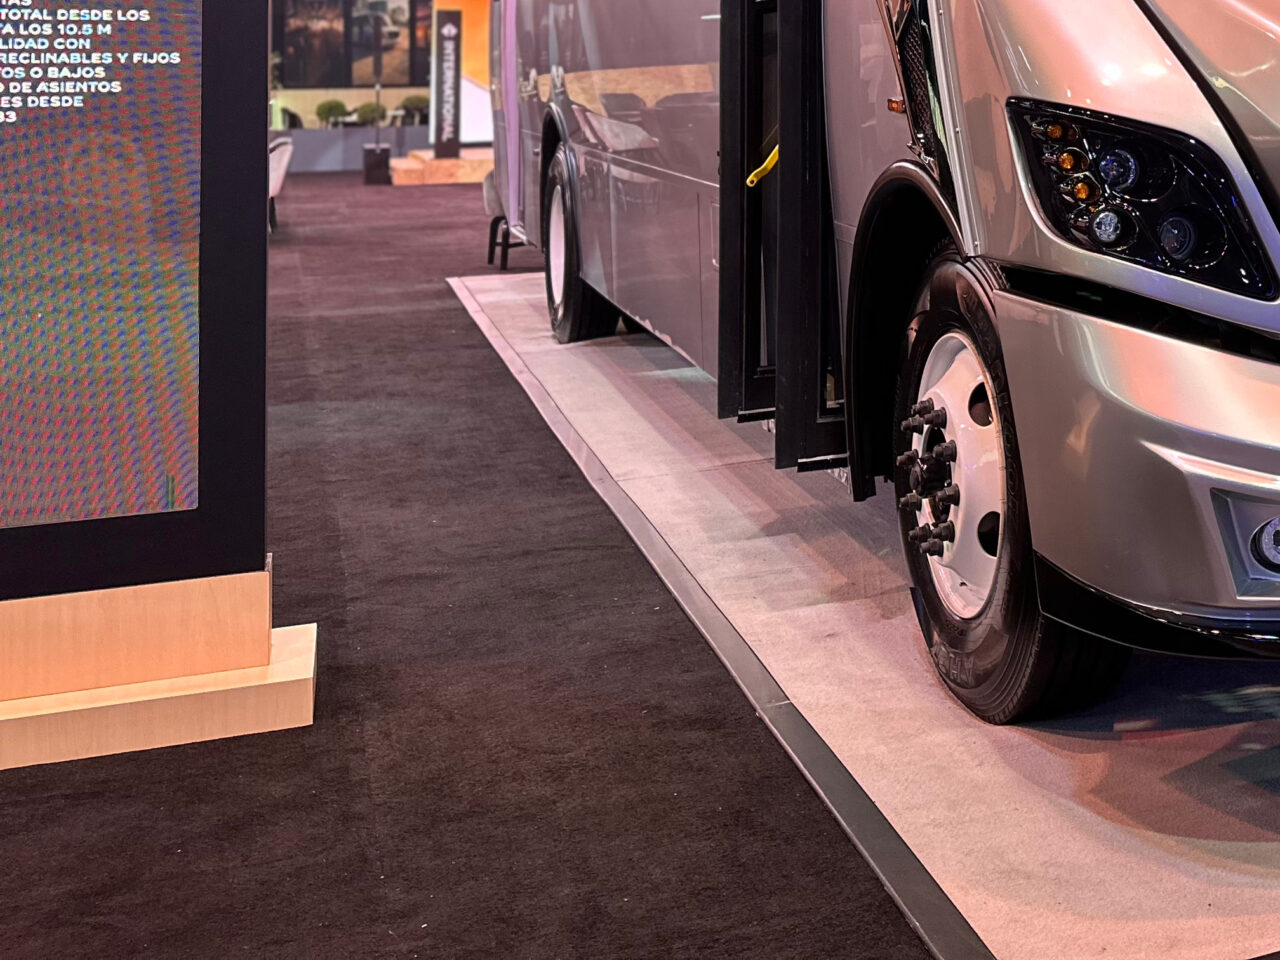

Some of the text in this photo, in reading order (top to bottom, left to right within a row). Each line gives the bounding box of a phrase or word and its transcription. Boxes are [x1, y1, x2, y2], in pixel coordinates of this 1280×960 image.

[0, 8, 150, 21] TOTAL DESDE LOS
[19, 23, 53, 35] LOS
[57, 23, 93, 36] 10.5
[97, 24, 111, 35] M
[0, 38, 91, 50] LIDAD CON
[116, 52, 129, 64] Y
[132, 52, 181, 64] FIJOS
[0, 67, 106, 78] OS O BAJOS
[9, 82, 32, 93] DE
[36, 81, 122, 93] ASIENTOS
[27, 96, 84, 107] DESDE
